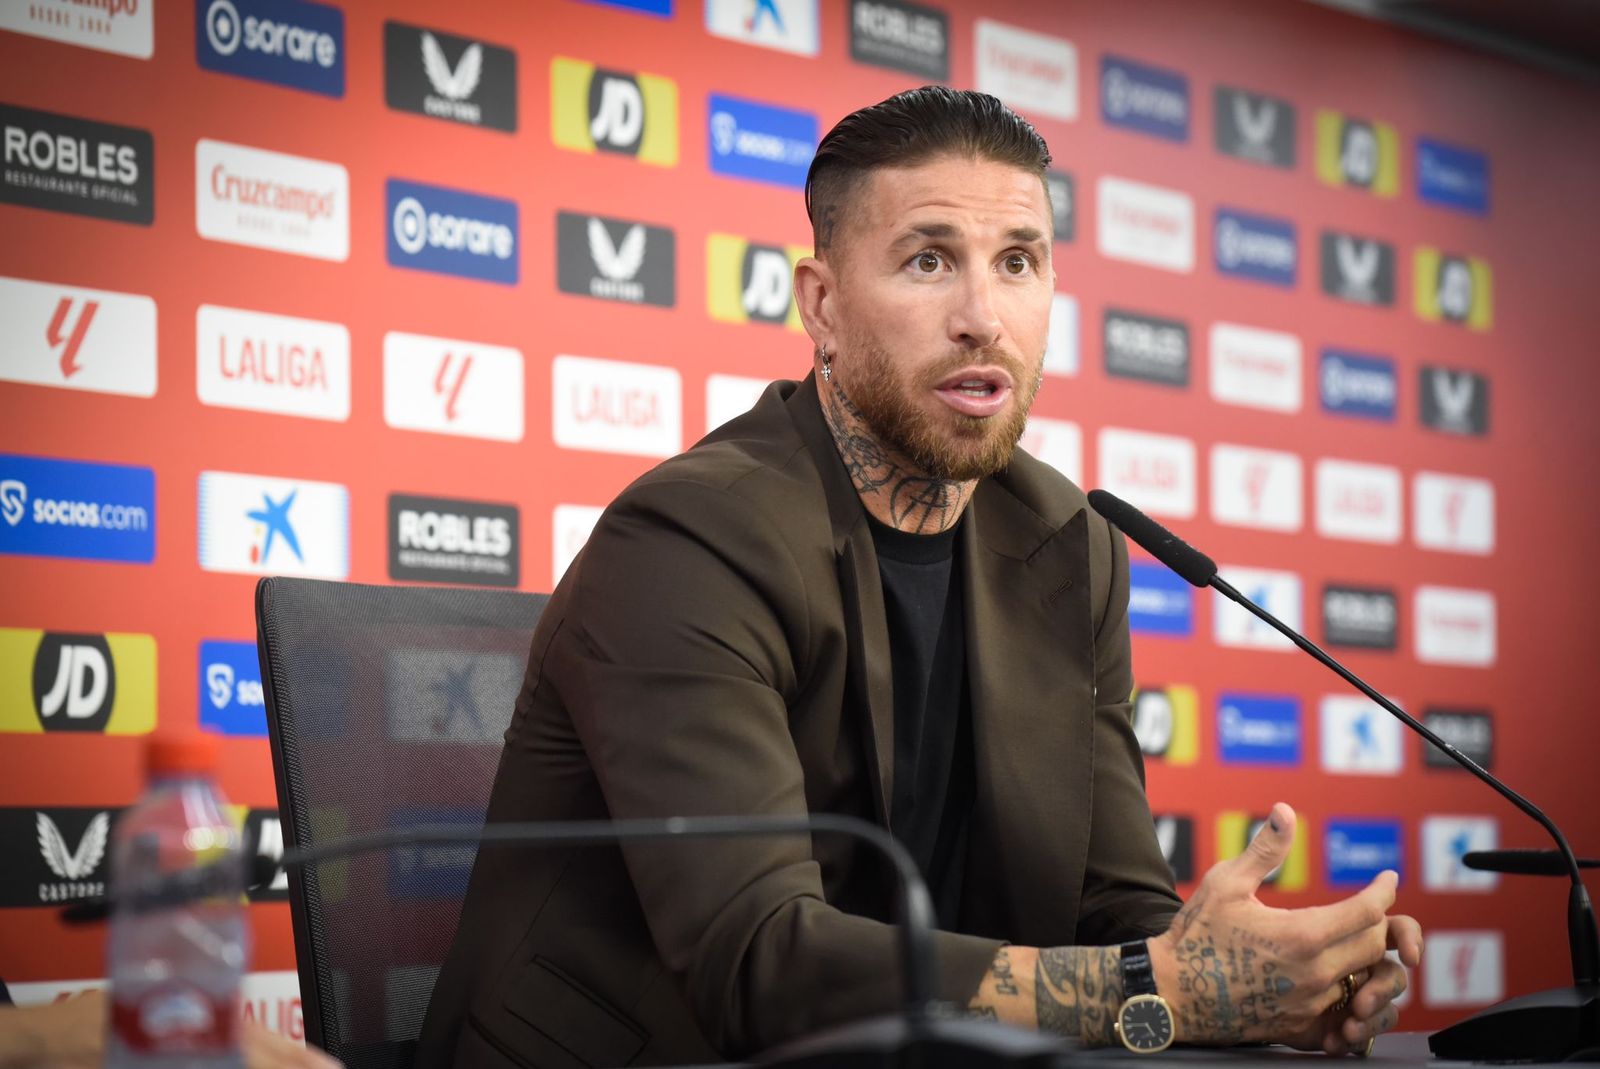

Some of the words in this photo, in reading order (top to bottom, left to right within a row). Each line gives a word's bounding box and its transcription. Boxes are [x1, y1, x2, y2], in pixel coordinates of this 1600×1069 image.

[243, 16, 336, 68] sorare
[589, 77, 644, 147] JD
[4, 125, 139, 186] ROBLES
[210, 163, 335, 221] Cruzcampo
[426, 212, 514, 260] sorare
[218, 333, 328, 392] LALIGA
[398, 508, 513, 558] ROBLES
[41, 644, 109, 719] JD
